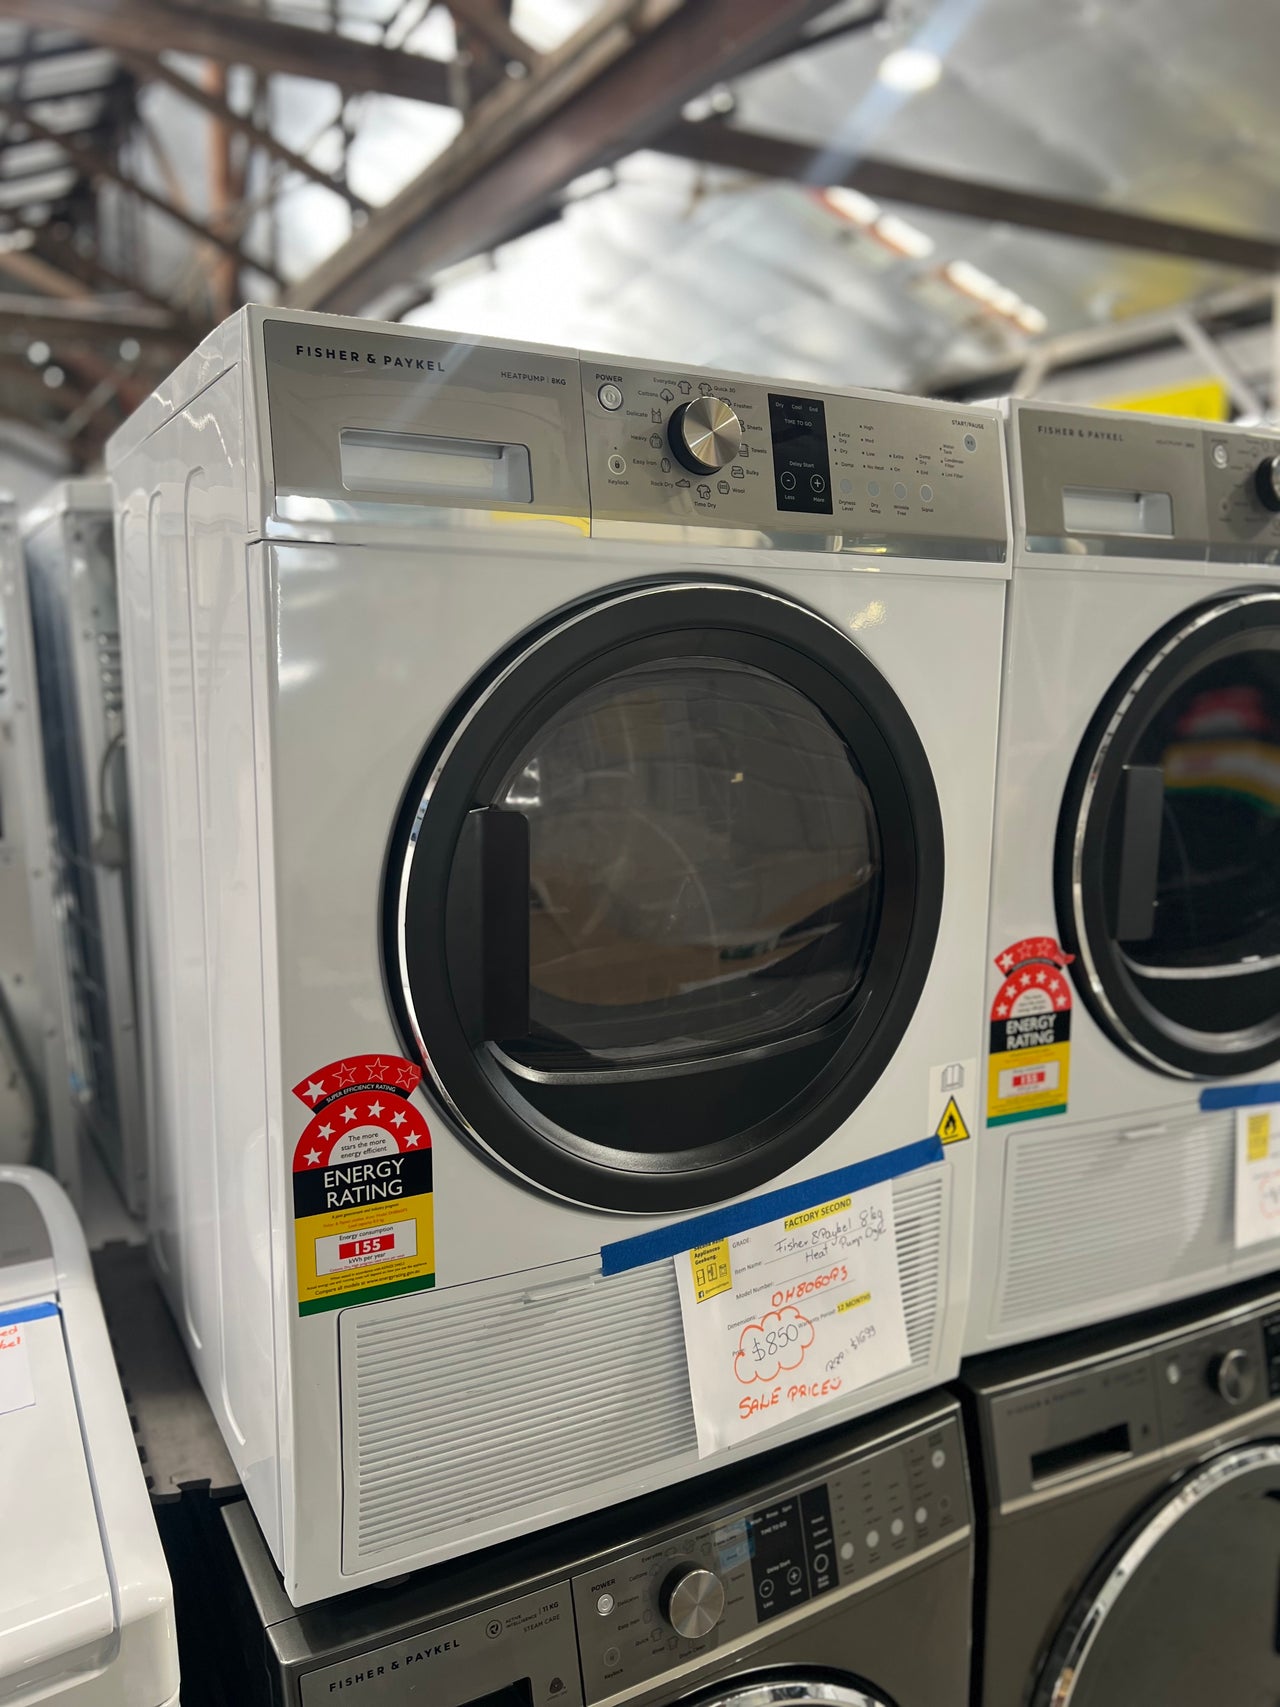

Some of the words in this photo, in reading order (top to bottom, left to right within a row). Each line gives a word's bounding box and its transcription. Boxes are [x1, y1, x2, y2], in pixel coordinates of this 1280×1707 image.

[296, 345, 360, 362] FISHER
[367, 353, 376, 364] &
[384, 355, 445, 372] PAYKEL
[500, 371, 544, 383] HEATPUMP
[551, 377, 566, 386] 8KG
[595, 373, 623, 383] POWER
[653, 377, 677, 386] Everyday
[637, 390, 659, 398] Cottons
[733, 402, 753, 410] Freshen
[626, 410, 648, 418] Delicate
[952, 419, 985, 430] START/PAUSE
[1038, 425, 1075, 438] FISHER
[1078, 430, 1085, 438] &
[1088, 430, 1124, 442] PAYKEL
[632, 458, 645, 466] Easy
[789, 460, 802, 468] Delay
[1005, 1013, 1057, 1035] ENERGY
[1006, 1029, 1055, 1050] RATING
[326, 1091, 344, 1103] SUPER
[343, 1084, 374, 1095] EFFICIENCY
[375, 1084, 396, 1093] RATING
[362, 1132, 379, 1140] more
[341, 1143, 357, 1151] stars
[357, 1140, 369, 1149] the
[369, 1138, 386, 1146] more
[341, 1151, 361, 1159] energy
[363, 1146, 387, 1154] efficient
[324, 1158, 405, 1188] ENERGY
[327, 1179, 403, 1208] RATING
[784, 1209, 820, 1230] FACTORY
[820, 1198, 852, 1216] SECOND
[339, 1234, 358, 1242] Energy
[359, 1226, 393, 1237] consumption
[355, 1238, 381, 1254] 155
[694, 1246, 720, 1259] Appliances
[774, 1238, 808, 1253] Fisher
[805, 1244, 829, 1262] Heat
[348, 1256, 362, 1264] kWh
[363, 1255, 373, 1263] per
[374, 1252, 386, 1261] year
[734, 1266, 746, 1275] Item
[315, 1287, 337, 1296] Compare
[343, 1281, 360, 1289] models
[735, 1289, 752, 1300] Model
[837, 1304, 844, 1313] 12
[845, 1293, 871, 1308] MONTHS
[752, 1323, 798, 1362] $850
[738, 1385, 781, 1420] SALE
[787, 1378, 831, 1401] PRICE
[761, 1527, 772, 1536] TIME
[779, 1520, 787, 1528] GO
[591, 1578, 616, 1592] POWER
[549, 1601, 559, 1609] KG
[505, 1614, 522, 1624] ACTIVE
[505, 1613, 537, 1629] INTELLIGENCE
[523, 1620, 543, 1633] STEAM
[544, 1613, 560, 1625] CARE
[329, 1665, 386, 1693] FISHER
[391, 1660, 400, 1671] &
[405, 1638, 461, 1666] PAYKEL
